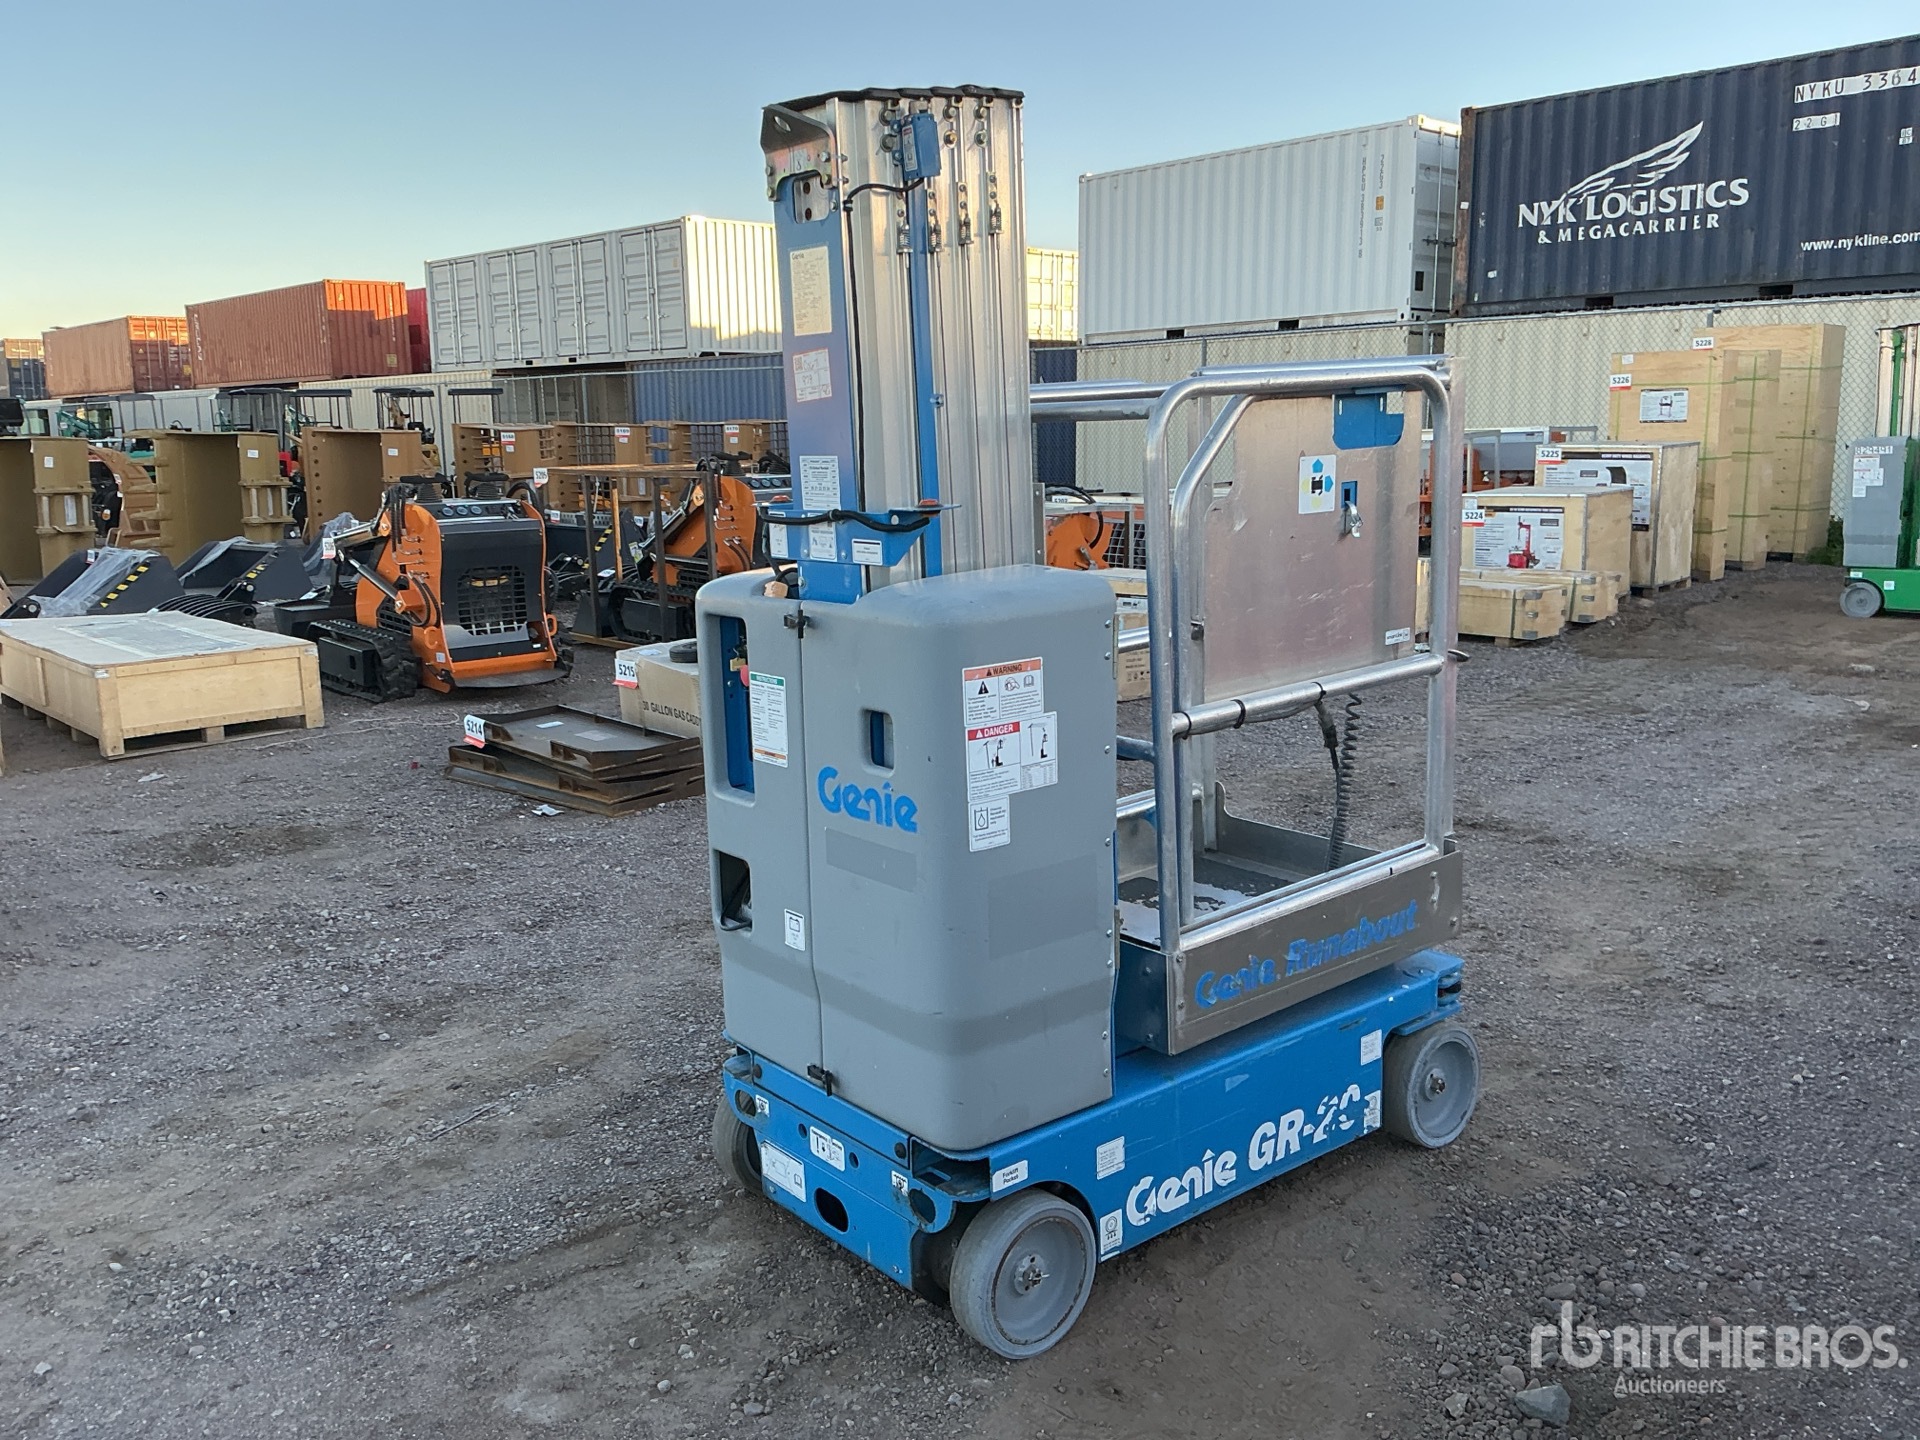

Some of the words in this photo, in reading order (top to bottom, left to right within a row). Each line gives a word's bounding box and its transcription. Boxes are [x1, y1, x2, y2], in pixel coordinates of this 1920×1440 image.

[1795, 79, 1845, 102] NYKU
[1862, 68, 1918, 90] 3364
[1517, 197, 1578, 229] NYK
[1586, 178, 1750, 221] LOGISTICS
[1537, 230, 1552, 245] &
[1557, 213, 1720, 242] MEGACARRIER
[1800, 232, 1920, 252] www.nykline.com
[1612, 376, 1630, 385] 5226
[1541, 449, 1560, 458] 5225
[1465, 511, 1484, 520] 5224
[618, 663, 636, 678] 5215
[992, 663, 1023, 676] WARNING
[650, 702, 674, 717] GALLON
[673, 708, 686, 721] GAS
[466, 719, 483, 736] 5214
[984, 723, 1014, 736] DANGER
[817, 765, 918, 834] Genie
[1286, 899, 1418, 977] Runabout
[1003, 1174, 1019, 1185] Pocket
[1126, 1148, 1237, 1227] Genie
